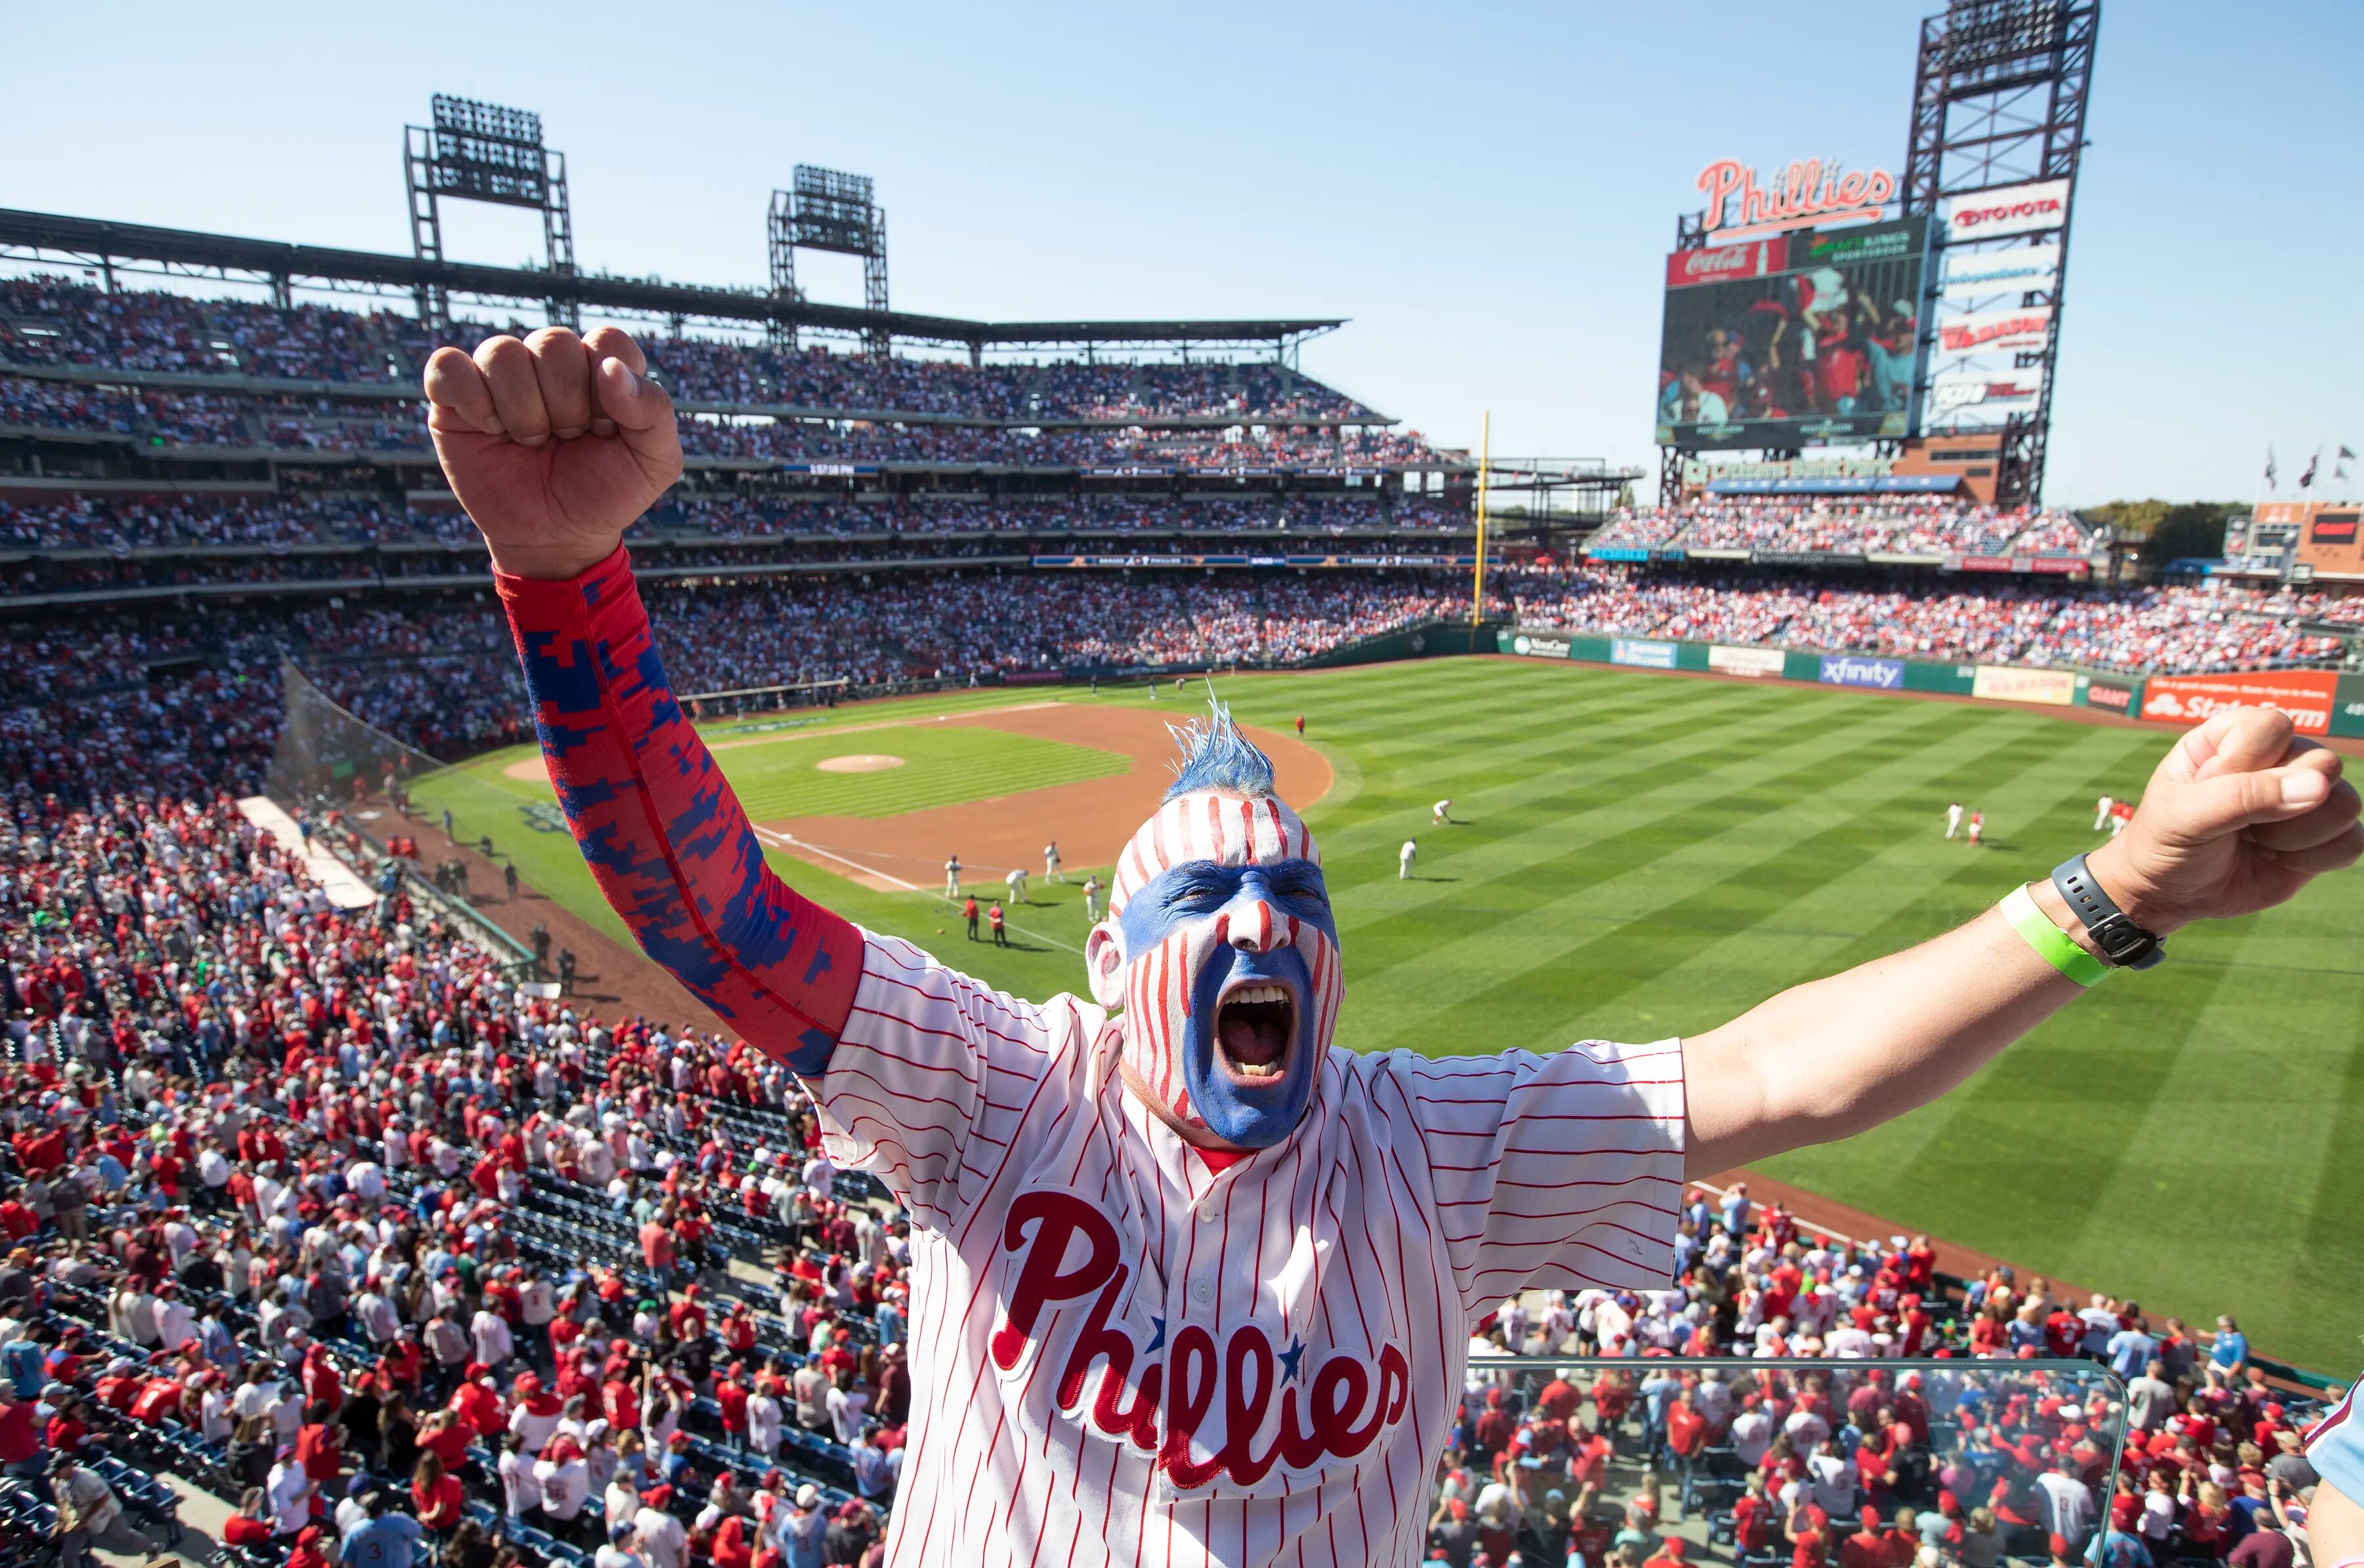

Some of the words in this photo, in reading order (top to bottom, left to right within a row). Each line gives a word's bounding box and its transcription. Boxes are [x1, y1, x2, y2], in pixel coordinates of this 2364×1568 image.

[1697, 158, 1894, 231] Phillies
[1982, 199, 2060, 222] TOYOTA
[1711, 460, 1789, 479] Citizens
[1791, 458, 1843, 477] Bank
[1845, 456, 1893, 476] Park
[1824, 658, 1899, 688] xfinity
[2088, 686, 2132, 708] GIANT
[990, 1190, 1409, 1489] Phillies
